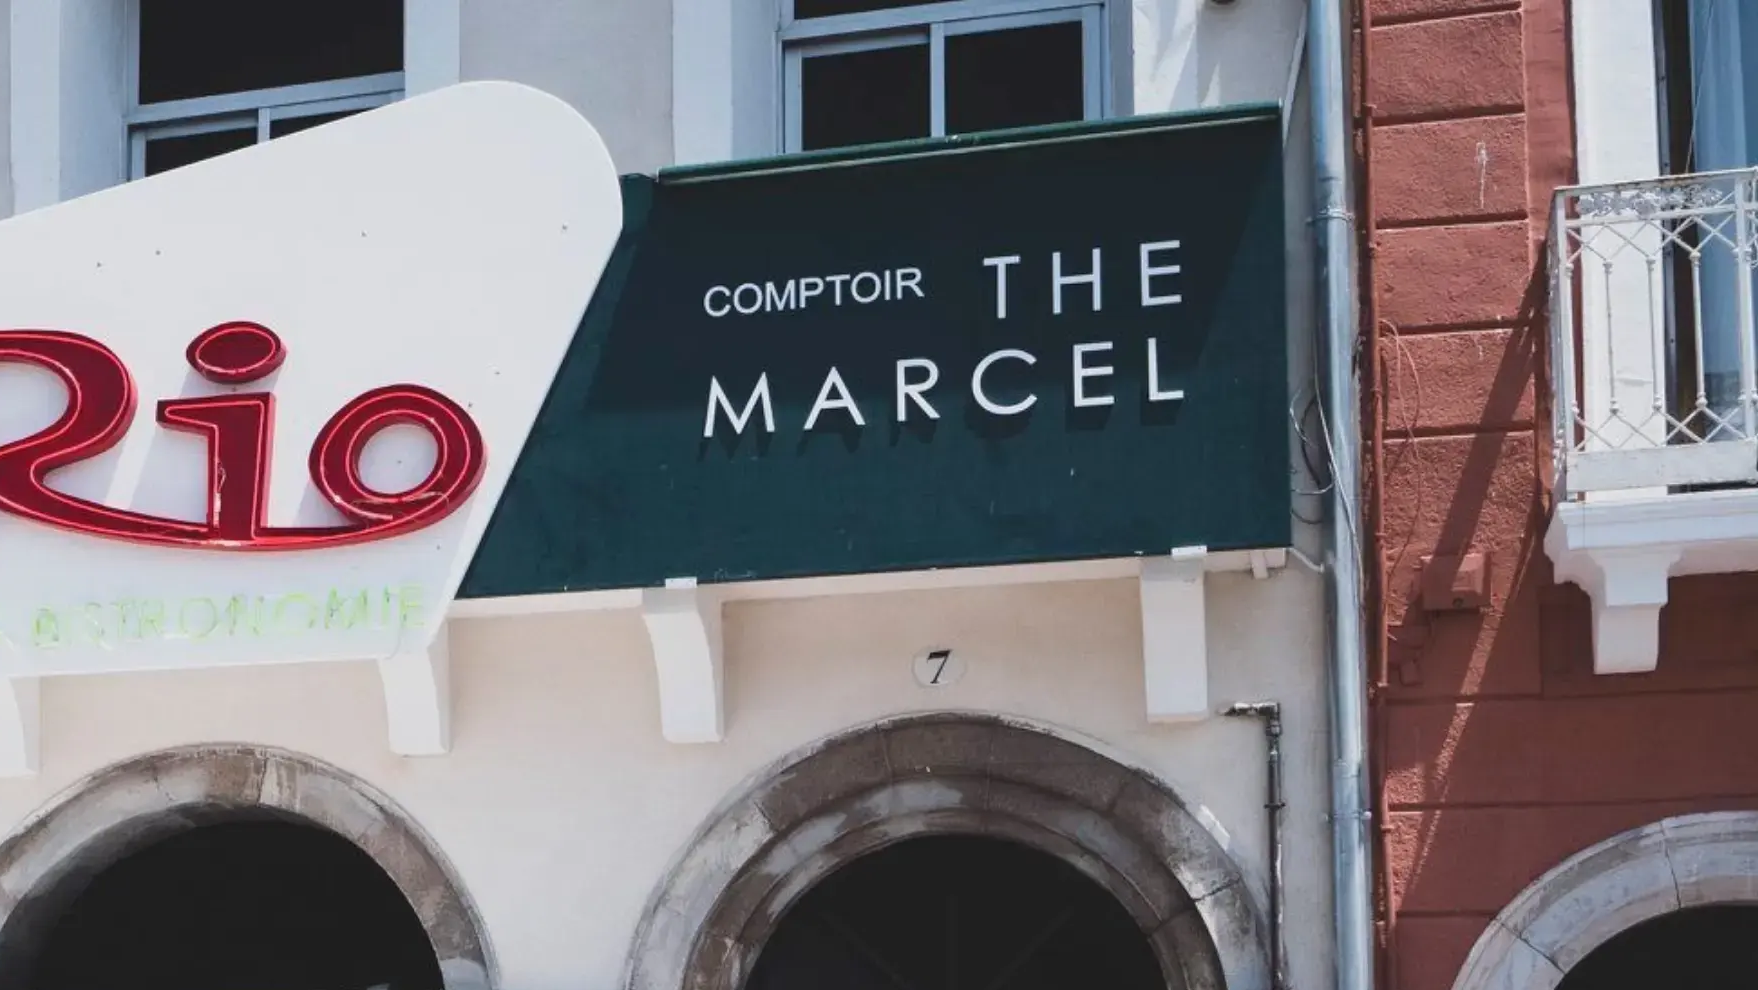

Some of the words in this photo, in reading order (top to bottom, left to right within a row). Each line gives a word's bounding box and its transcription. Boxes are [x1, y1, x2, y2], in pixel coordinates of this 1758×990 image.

[703, 266, 925, 318] COMPTOIR
[982, 239, 1183, 319] THE
[702, 337, 1185, 439] MARCEL
[926, 650, 952, 684] 7
